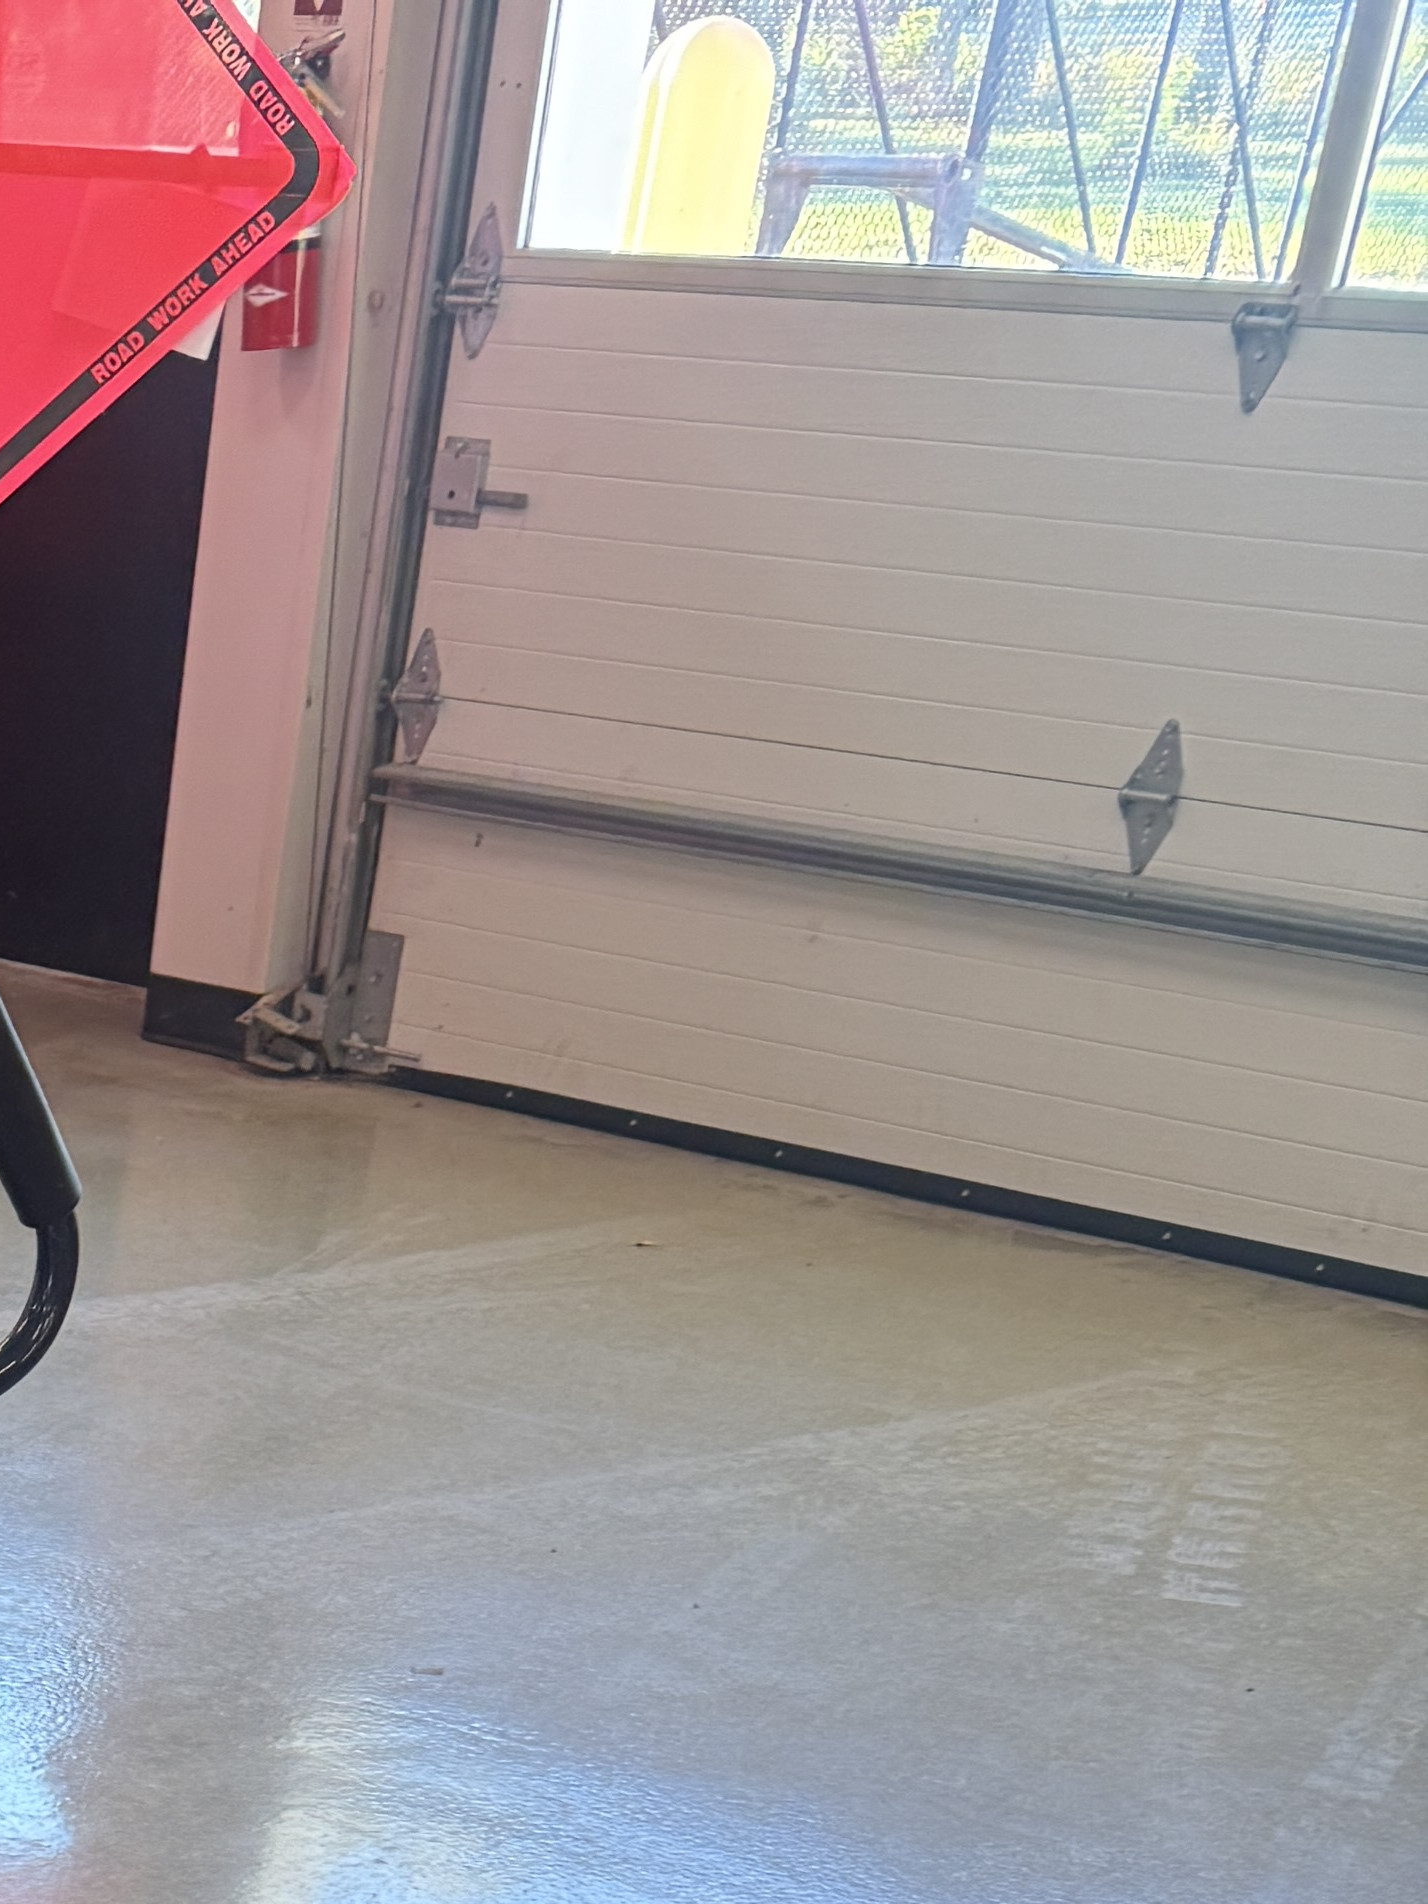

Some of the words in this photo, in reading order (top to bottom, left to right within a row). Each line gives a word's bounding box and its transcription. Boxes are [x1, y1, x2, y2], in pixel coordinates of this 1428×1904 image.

[202, 18, 251, 81] WORK
[248, 80, 295, 136] ROAD
[90, 331, 144, 385] ROAD
[146, 273, 209, 331] WORK
[209, 211, 276, 276] AHEAD
